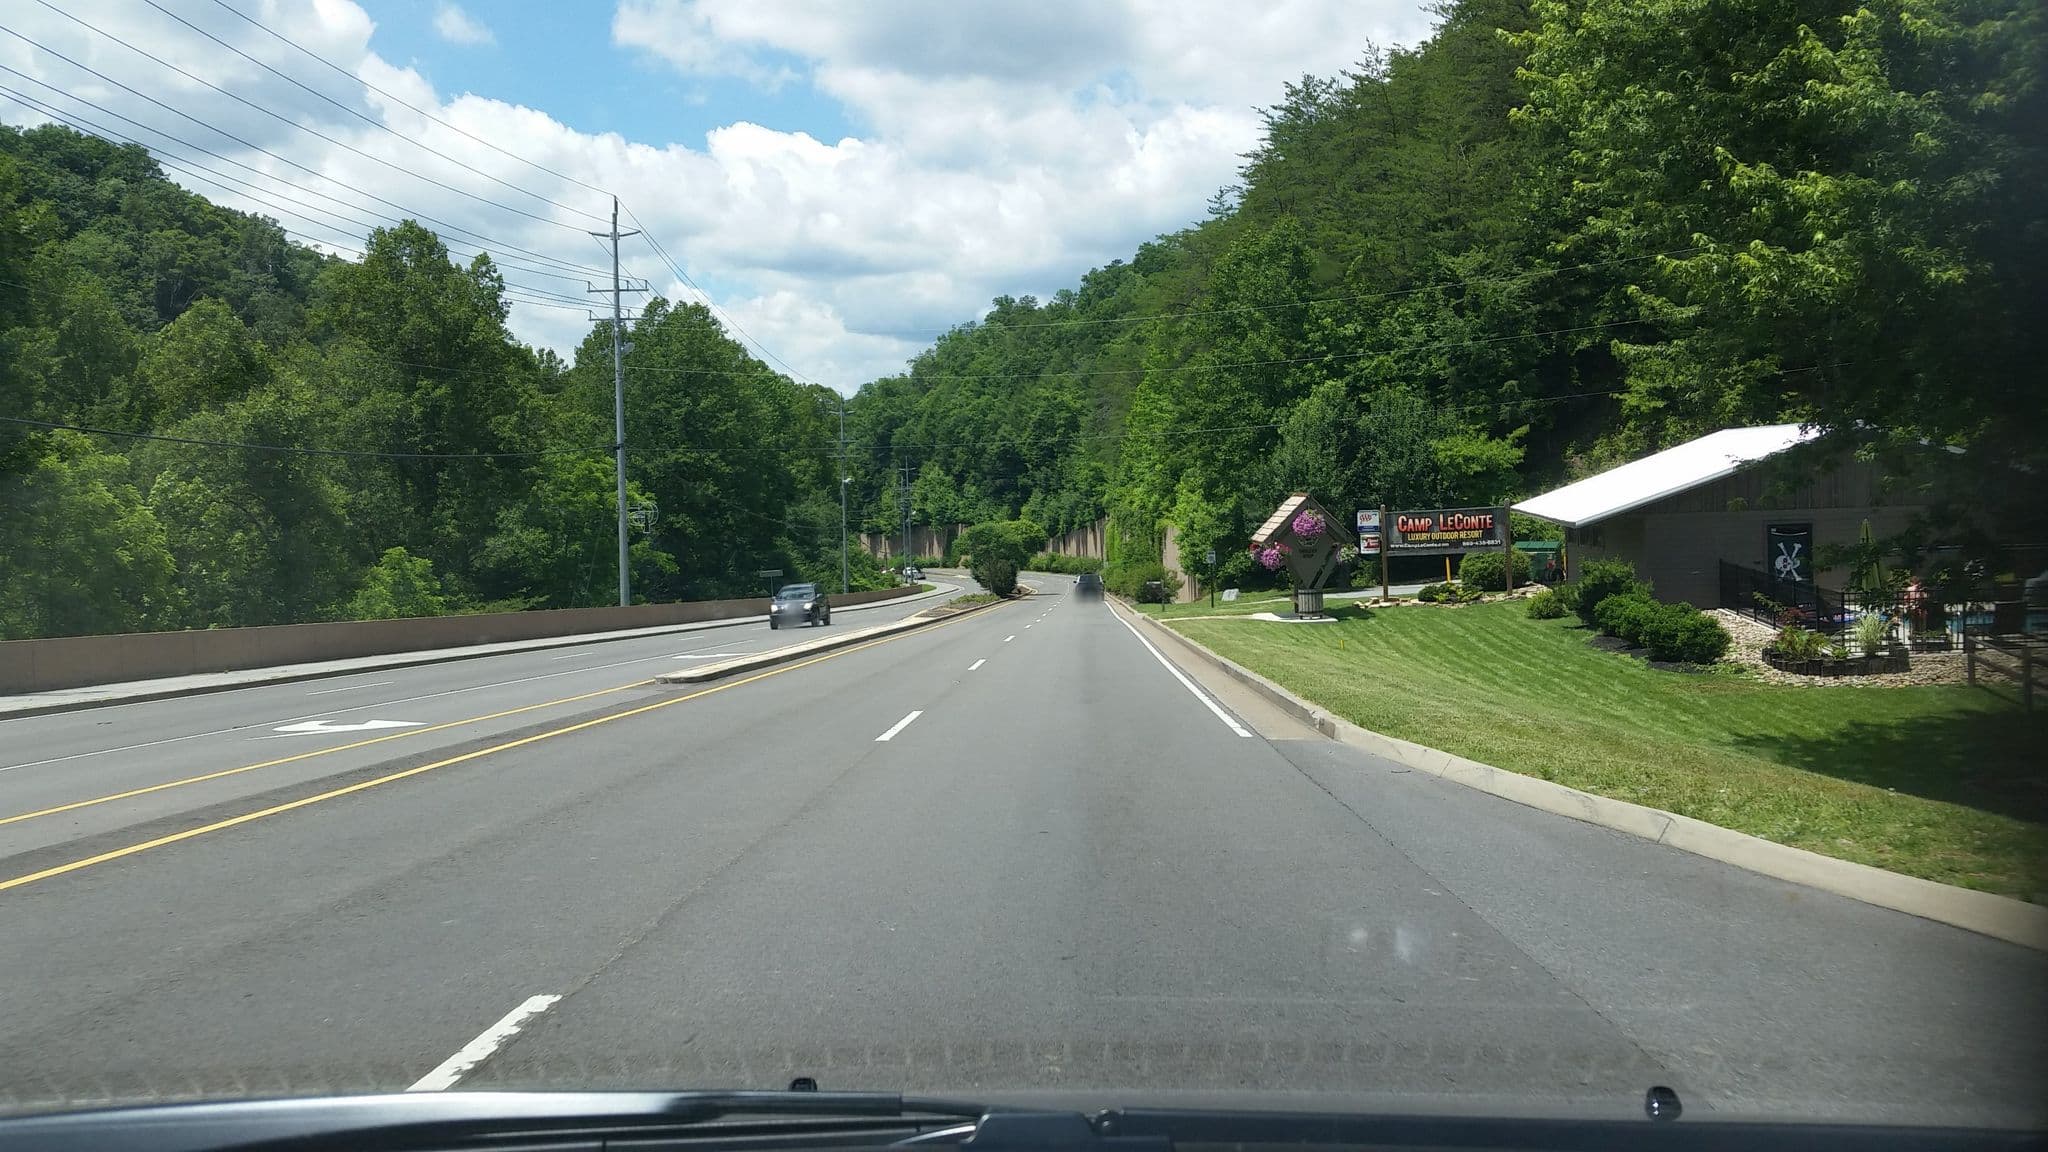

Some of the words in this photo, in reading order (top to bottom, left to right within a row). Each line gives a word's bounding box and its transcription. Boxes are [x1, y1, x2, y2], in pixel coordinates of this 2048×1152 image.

[1408, 532, 1430, 541] LUXURY
[1431, 531, 1459, 540] OUTDOOR
[1459, 530, 1483, 539] RESORT
